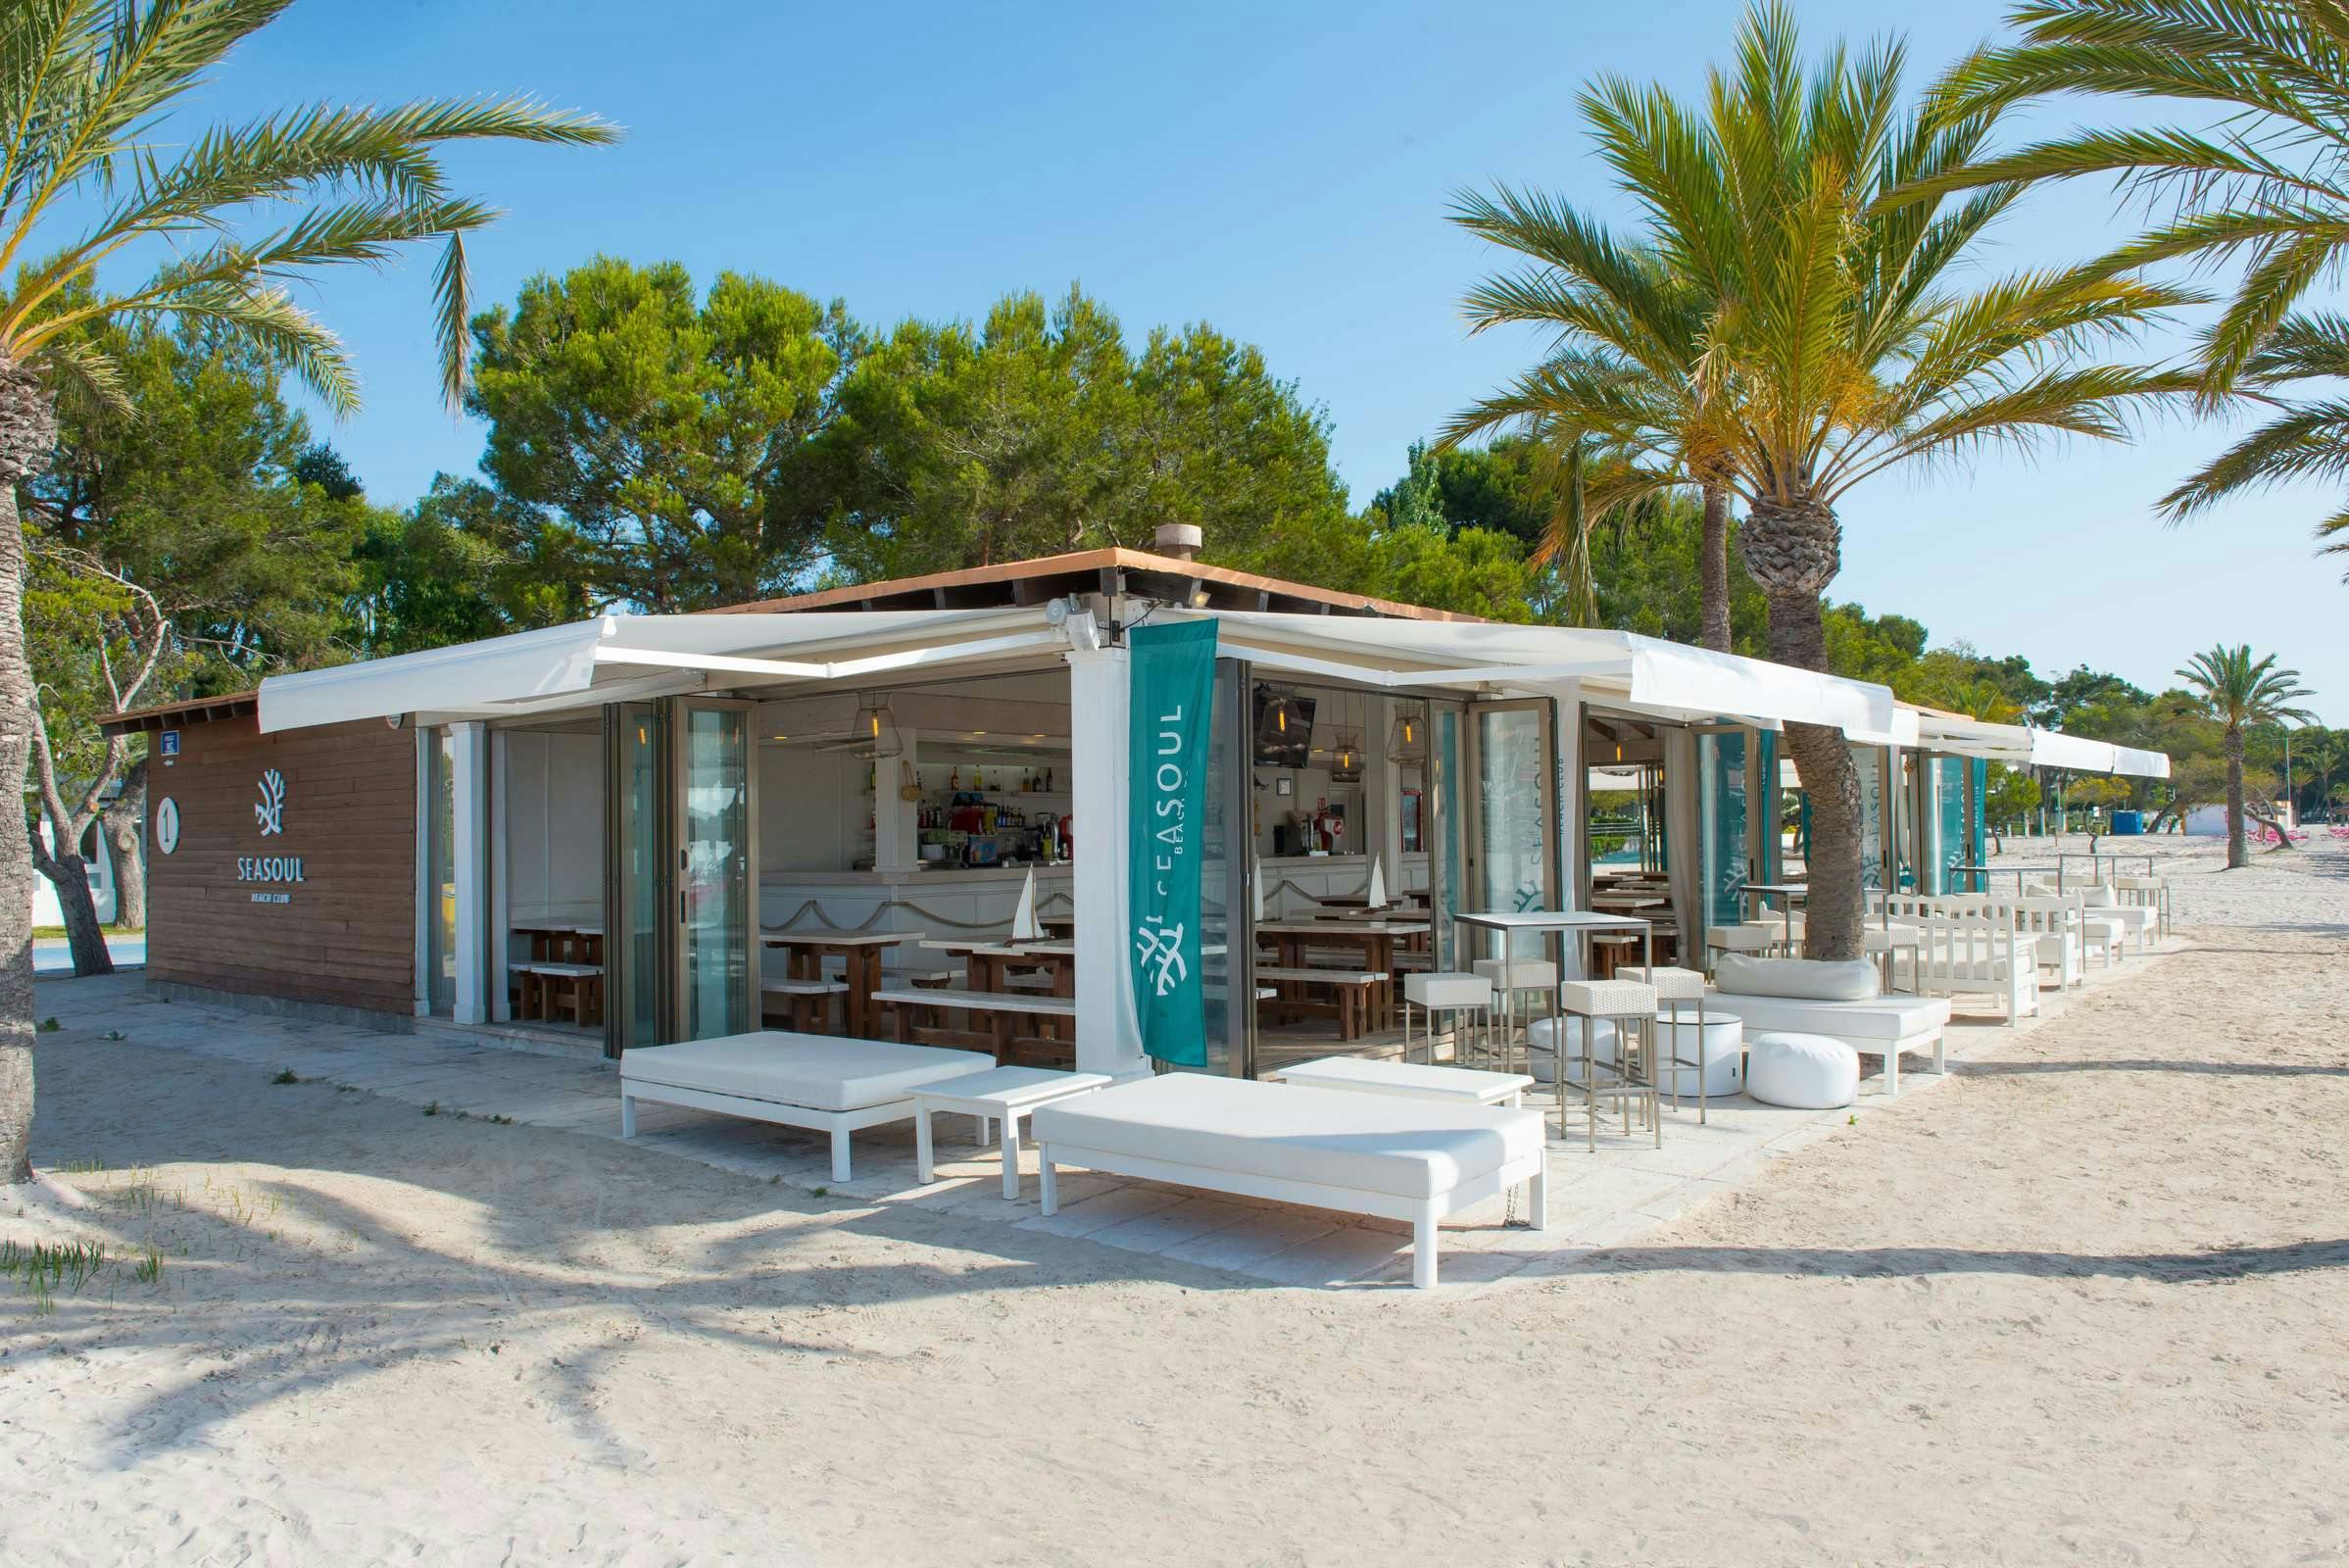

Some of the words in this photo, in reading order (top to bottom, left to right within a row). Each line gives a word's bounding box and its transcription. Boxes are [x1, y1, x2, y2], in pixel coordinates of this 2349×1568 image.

[163, 808, 170, 843] 1
[237, 857, 306, 882] SEASOUL
[251, 893, 272, 903] BEACH
[273, 893, 291, 904] CLUB
